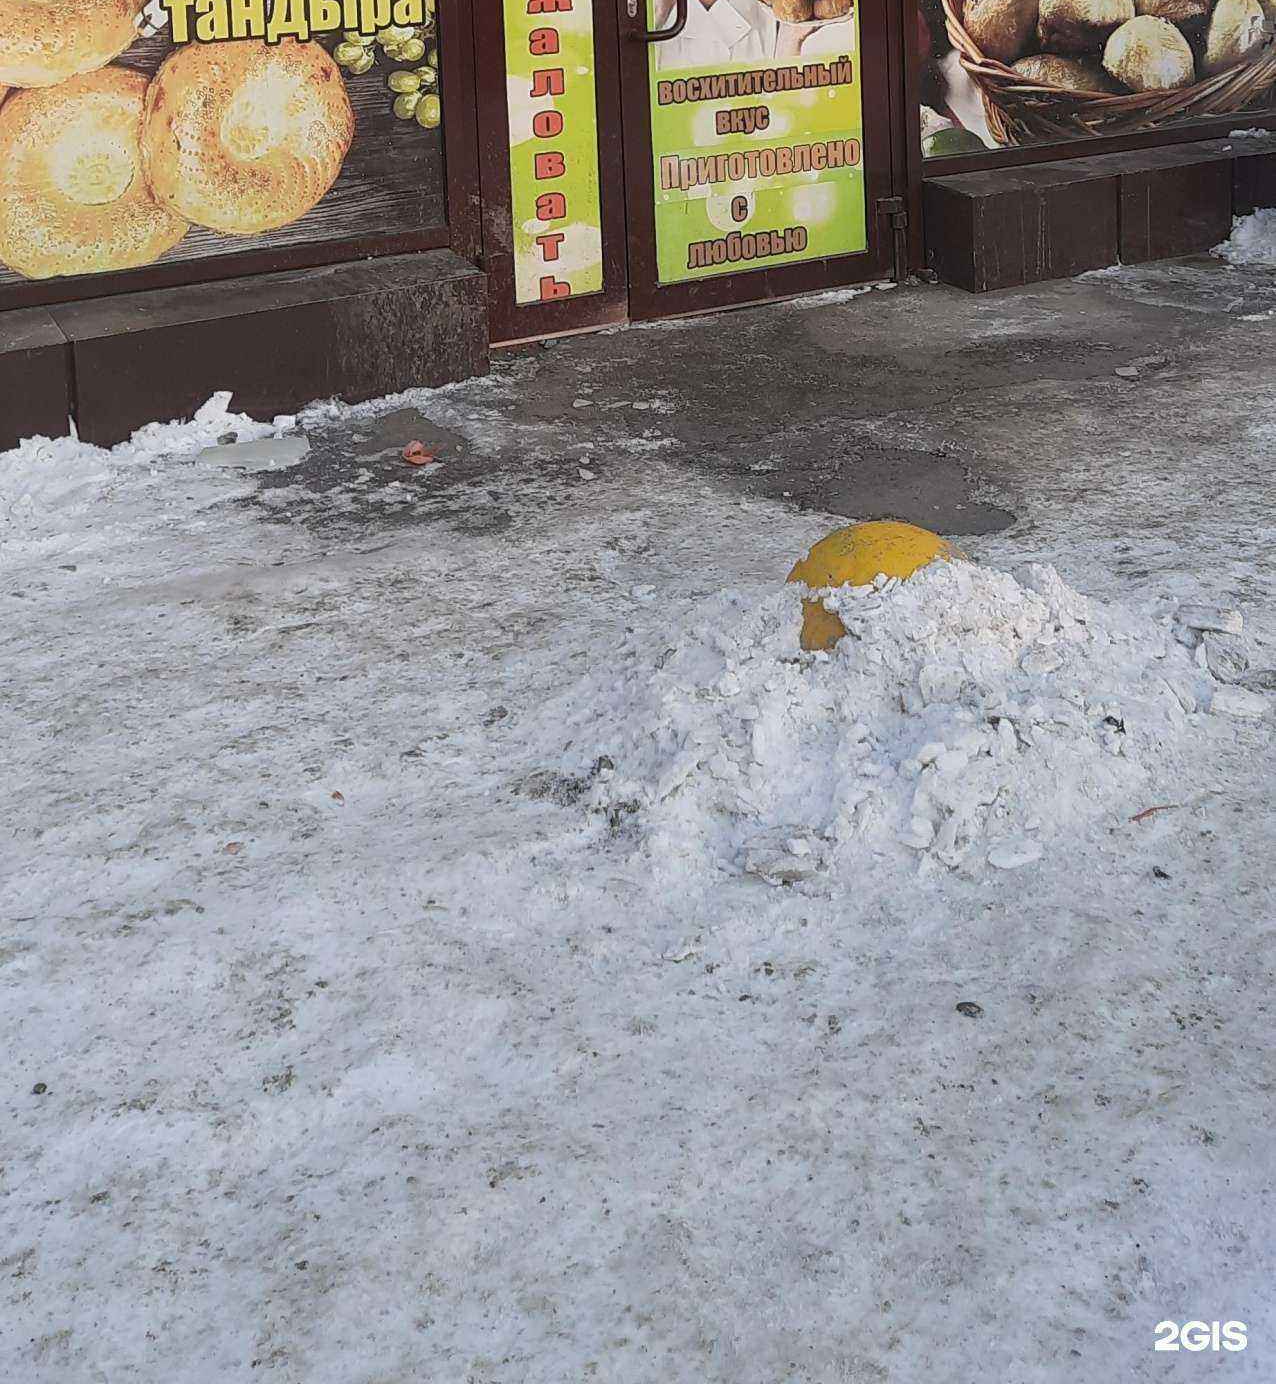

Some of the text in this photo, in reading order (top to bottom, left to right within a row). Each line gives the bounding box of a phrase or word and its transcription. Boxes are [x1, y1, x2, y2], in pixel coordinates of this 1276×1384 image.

[658, 56, 853, 106] восхитительный
[715, 105, 770, 136] вкус
[659, 137, 862, 192] Приготовлено
[686, 226, 809, 270] любовью
